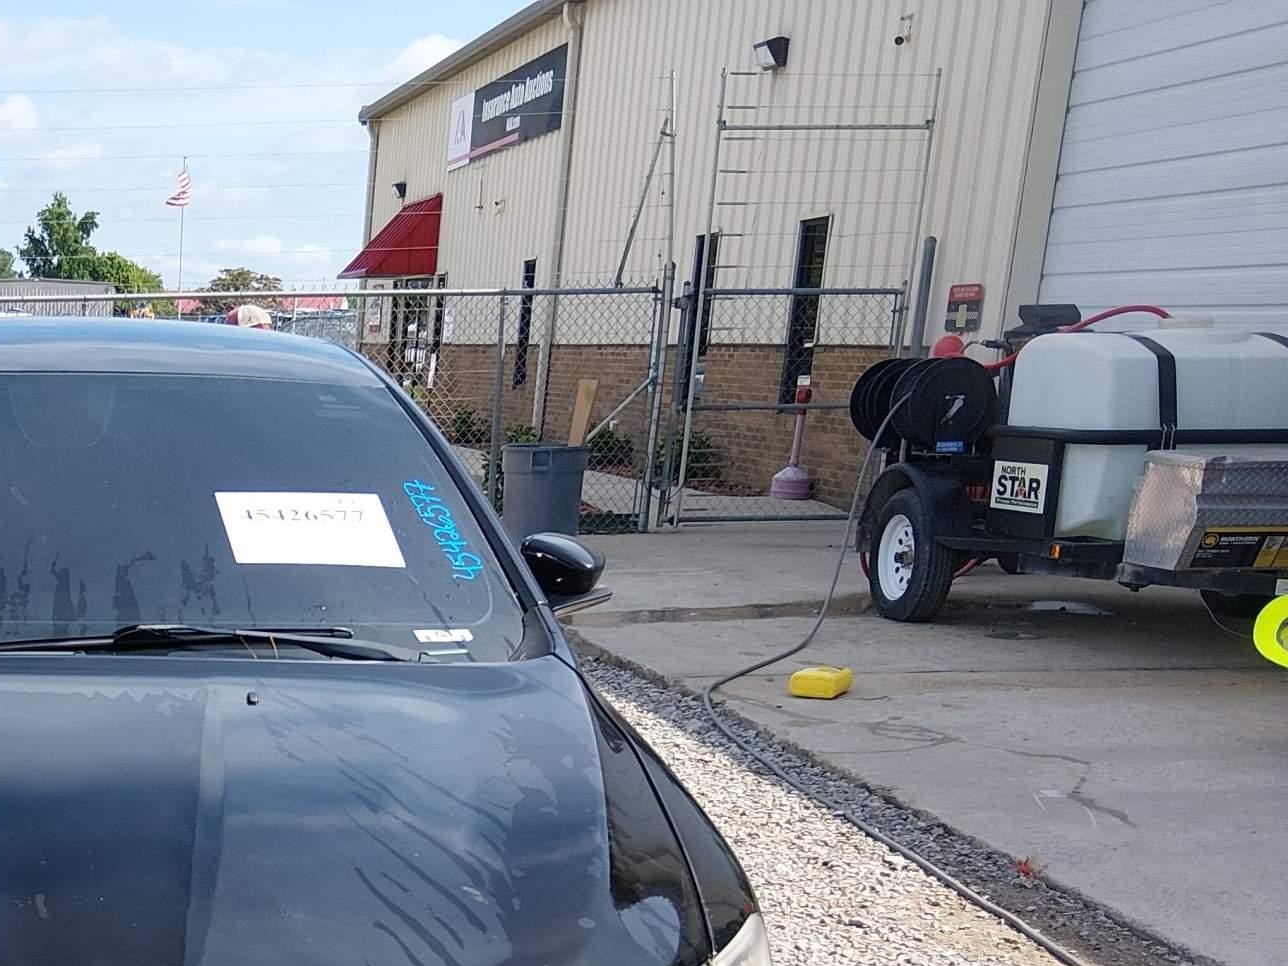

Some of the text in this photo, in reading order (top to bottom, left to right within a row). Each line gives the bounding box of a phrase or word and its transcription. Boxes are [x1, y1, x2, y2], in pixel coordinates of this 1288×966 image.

[481, 69, 554, 123] Insurance Auto Auctions
[1000, 465, 1027, 476] NORTH
[996, 474, 1041, 501] STAR
[241, 508, 364, 521] 45426577
[403, 479, 483, 579] 45426577
